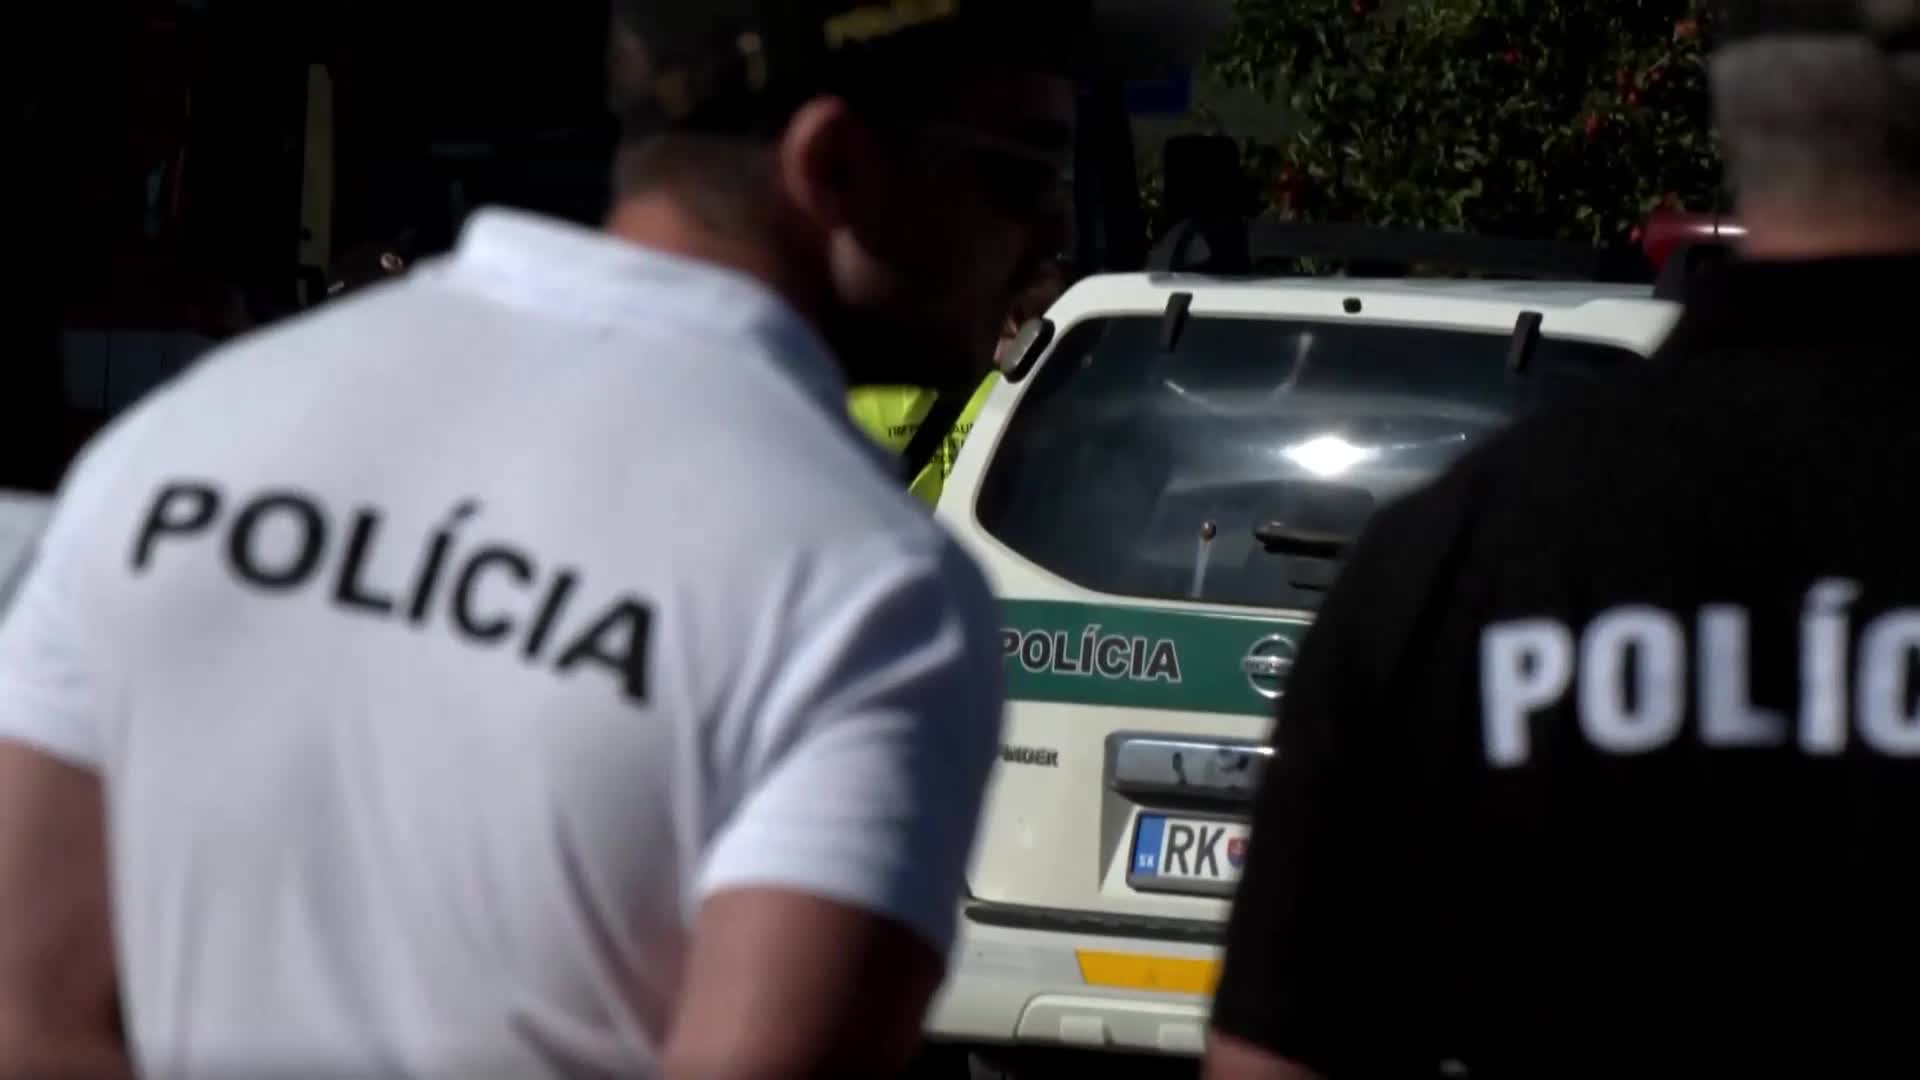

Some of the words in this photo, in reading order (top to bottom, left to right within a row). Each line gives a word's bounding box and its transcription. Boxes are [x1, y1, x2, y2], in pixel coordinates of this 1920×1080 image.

[132, 481, 656, 705] POLÍCIA
[1000, 624, 1182, 683] POLÍCIA
[1163, 823, 1226, 877] RK
